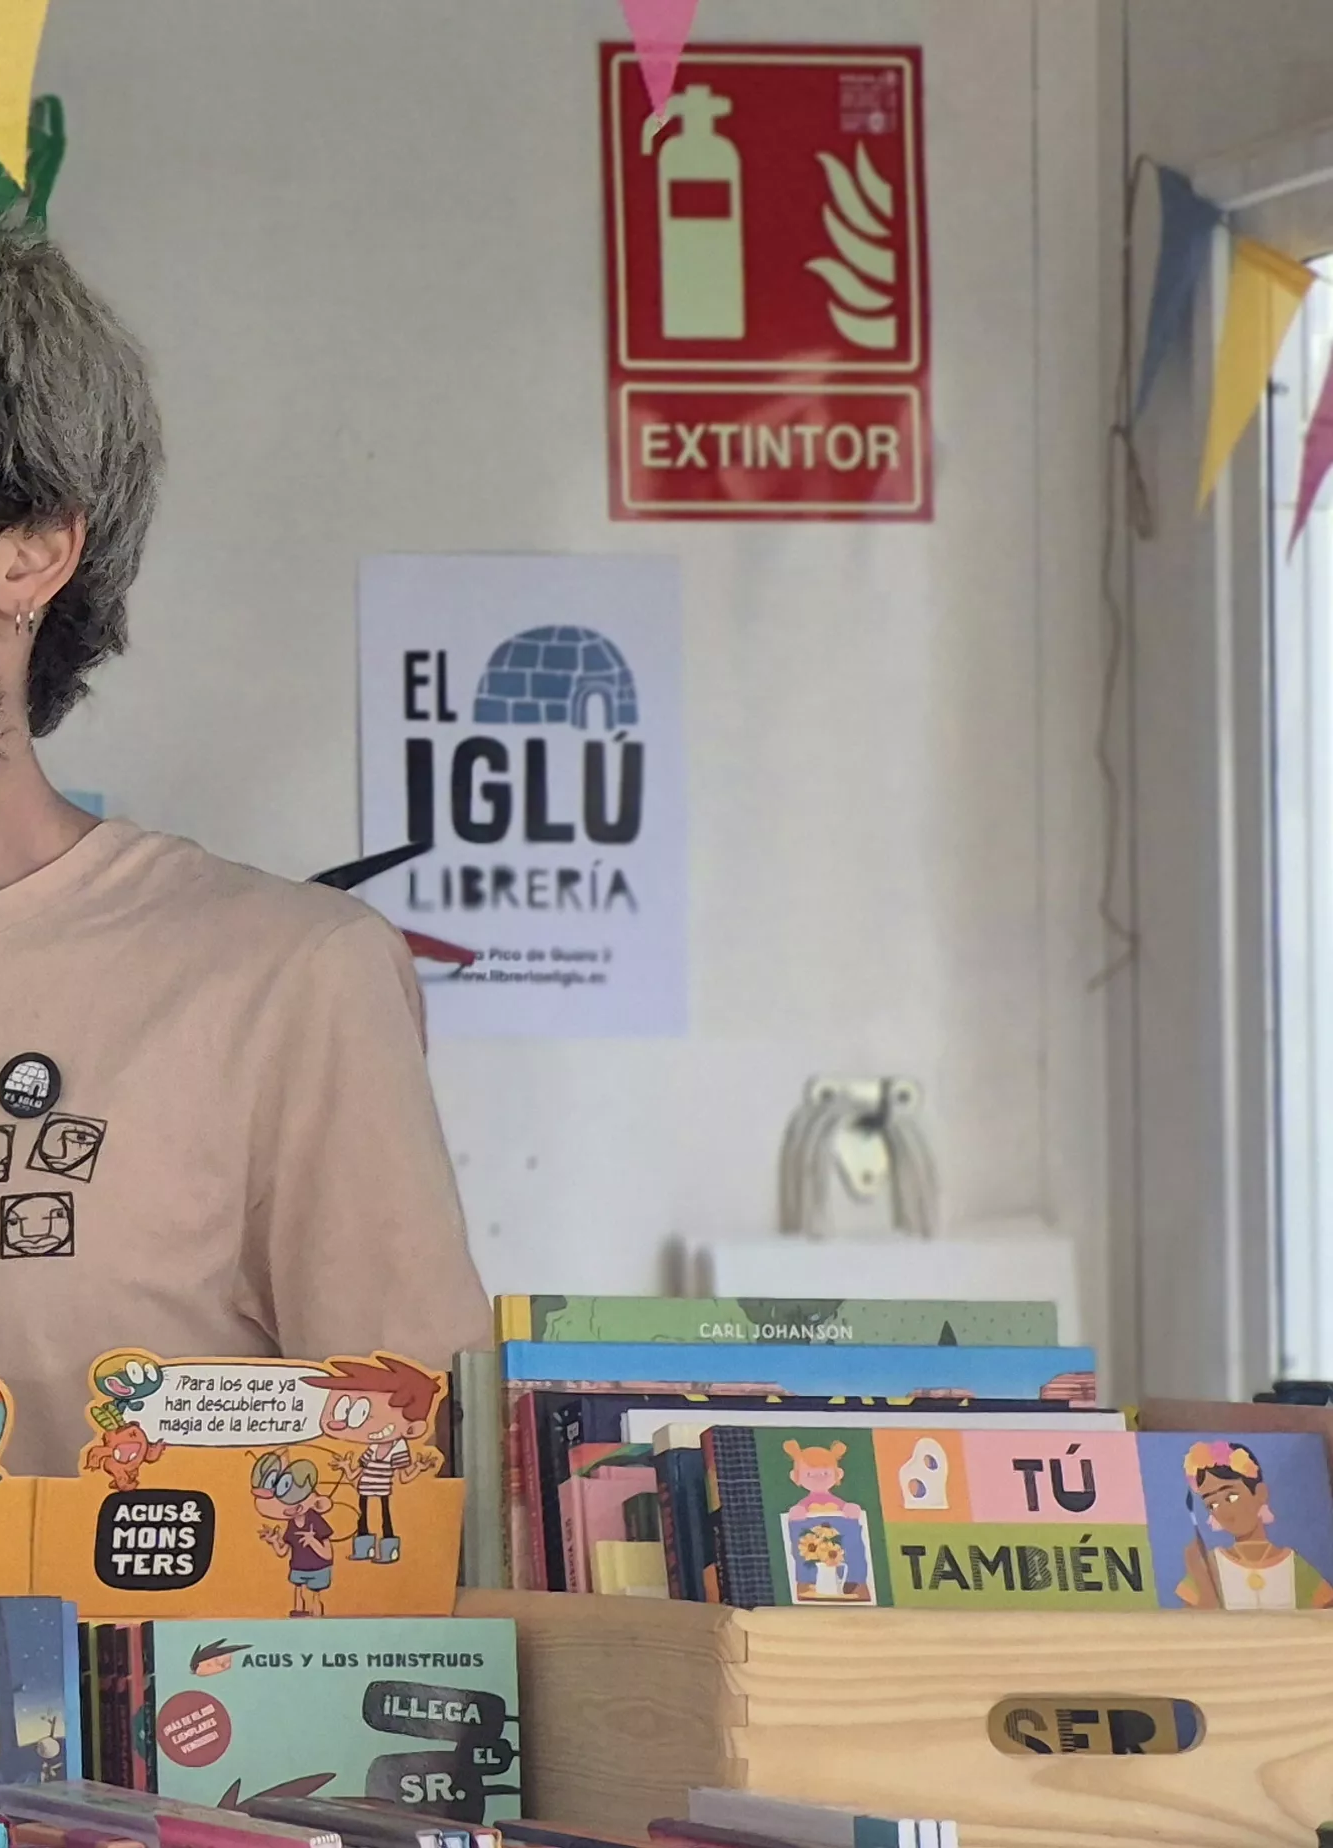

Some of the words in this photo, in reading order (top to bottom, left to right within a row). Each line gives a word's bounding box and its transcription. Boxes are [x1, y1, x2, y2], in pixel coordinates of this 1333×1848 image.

[641, 425, 899, 470] EXTINTOR
[403, 651, 457, 723] EL
[405, 731, 644, 846] IGLÚ
[406, 860, 640, 914] LIBRERÍA
[699, 1323, 747, 1341] CARL
[752, 1323, 853, 1342] JOHANSON
[175, 1375, 214, 1393] ¡Para
[219, 1374, 242, 1392] los
[246, 1379, 273, 1397] que
[278, 1379, 296, 1397] ya
[165, 1396, 192, 1413] han
[196, 1396, 287, 1414] descubierto
[291, 1397, 304, 1413] la
[159, 1416, 204, 1436] magia
[208, 1416, 226, 1433] de
[230, 1416, 243, 1433] la
[247, 1416, 307, 1433] lectura!
[1012, 1444, 1098, 1514] TÚ
[112, 1528, 197, 1550] MONS
[112, 1554, 194, 1576] TERS
[901, 1534, 1144, 1594] TAMBIÉN
[242, 1653, 293, 1668] AGUS
[301, 1653, 314, 1668] Y
[322, 1653, 359, 1668] LOS
[367, 1653, 484, 1669] MONSTRUOS
[382, 1694, 482, 1726] ¡LLEGA
[1004, 1709, 1156, 1755] SER
[473, 1747, 501, 1766] EL
[400, 1773, 466, 1804] SR.
